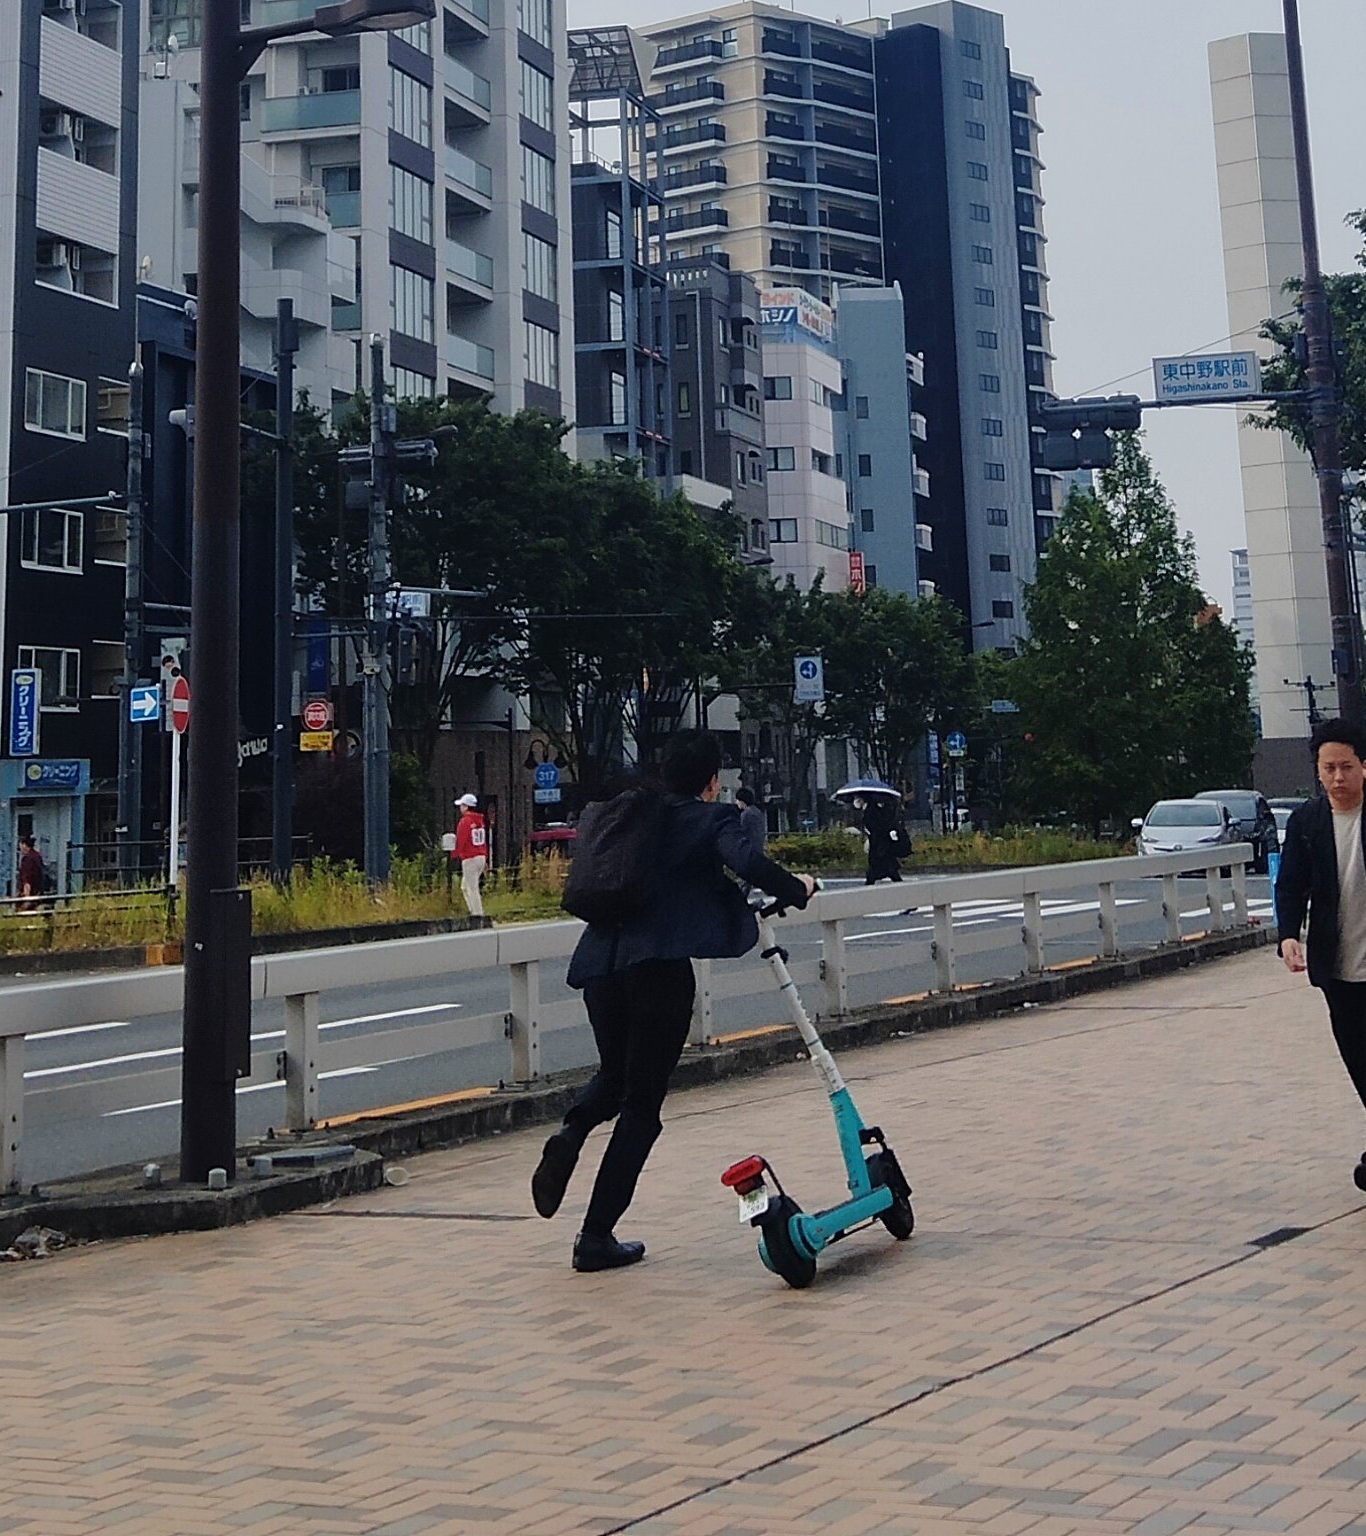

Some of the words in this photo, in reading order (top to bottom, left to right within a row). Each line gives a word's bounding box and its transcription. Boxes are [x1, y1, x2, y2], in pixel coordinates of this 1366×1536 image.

[1162, 358, 1249, 381] 東中野駅前
[1162, 381, 1229, 395] Higashinakano
[1232, 378, 1251, 389] Sta.
[18, 685, 32, 747] クリーニング
[538, 770, 556, 781] 317
